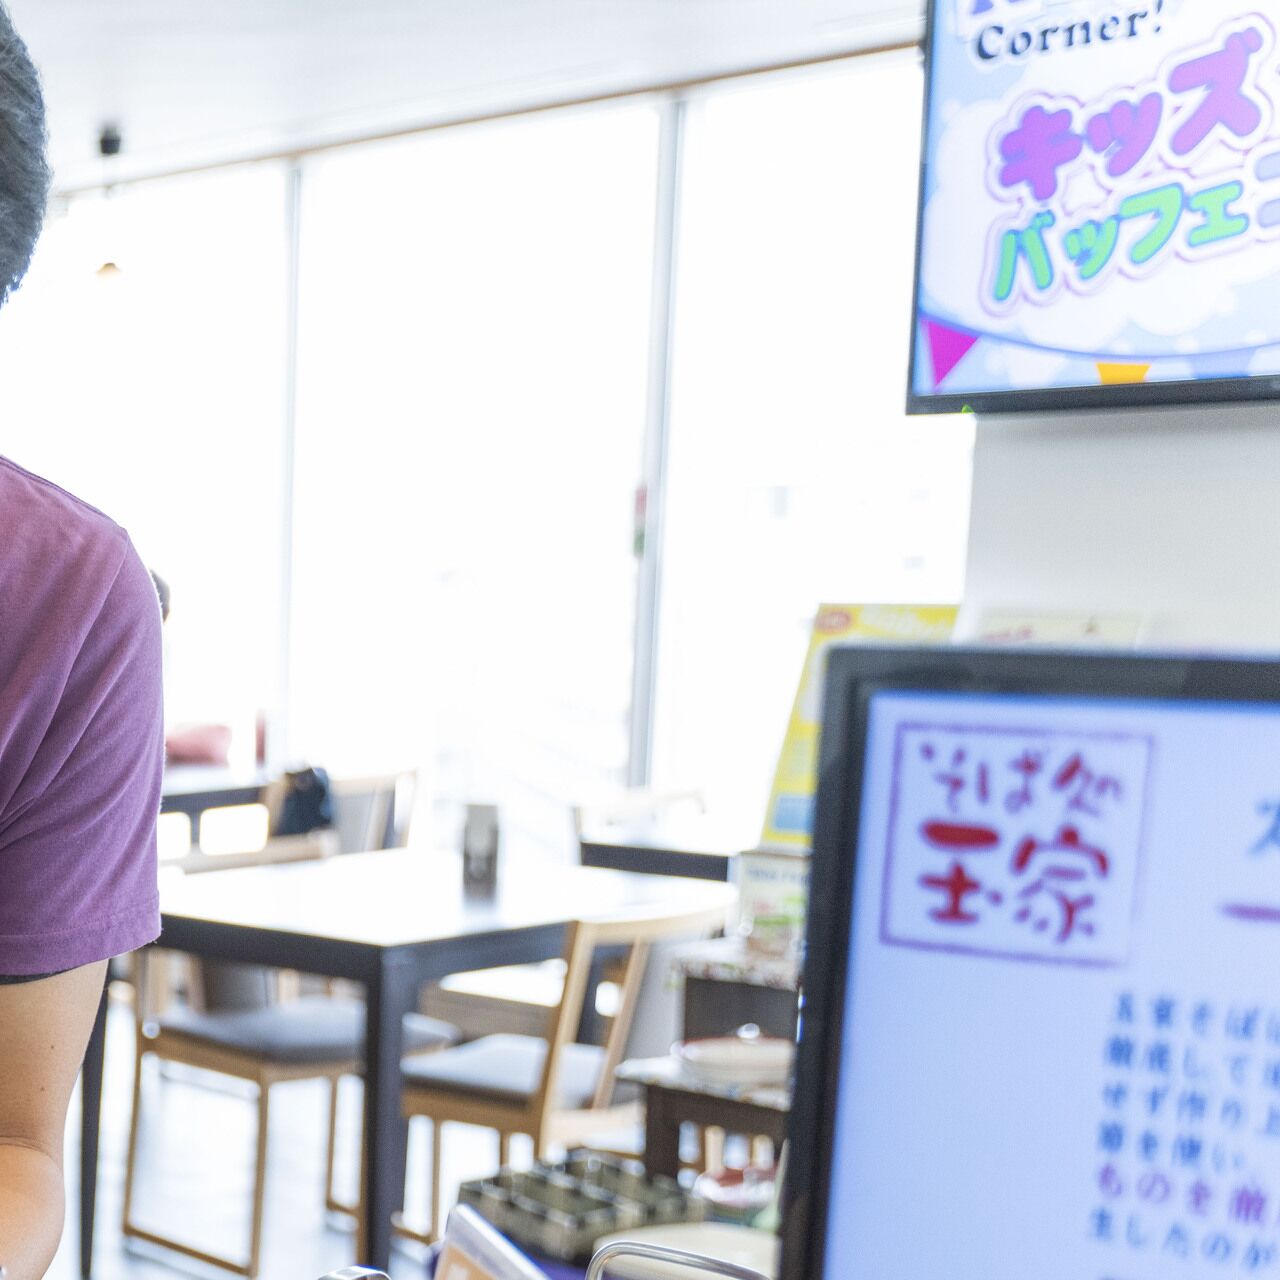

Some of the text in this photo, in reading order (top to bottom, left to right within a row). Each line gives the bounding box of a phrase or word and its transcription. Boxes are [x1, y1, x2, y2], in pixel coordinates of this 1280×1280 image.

[977, 0, 1164, 60] Corner!
[998, 27, 1263, 201] キッズ
